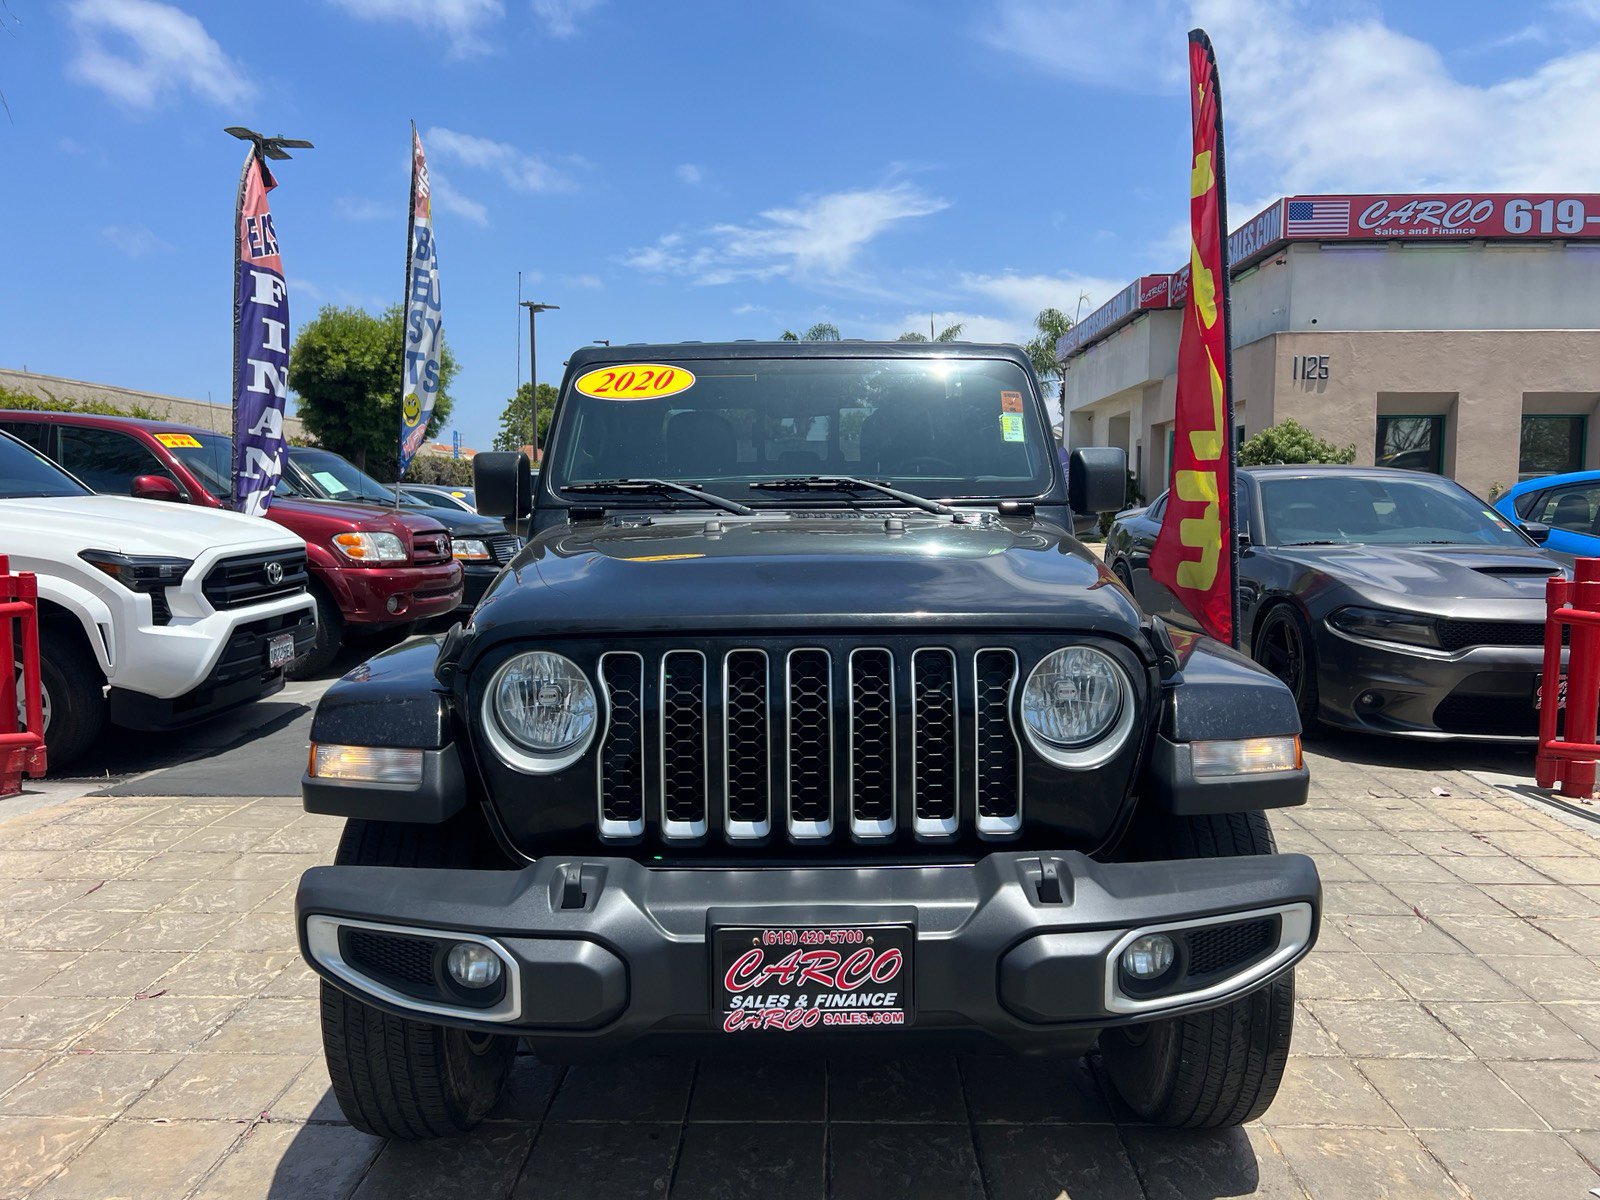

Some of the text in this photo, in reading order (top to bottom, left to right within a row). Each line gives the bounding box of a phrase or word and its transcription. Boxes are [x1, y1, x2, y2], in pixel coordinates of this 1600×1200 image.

[1358, 199, 1495, 229] CARCO
[1375, 227, 1476, 236] Sales and Finance
[1292, 354, 1330, 380] 1125
[593, 369, 675, 393] 2020
[762, 929, 864, 946] (619) 420-5700
[724, 947, 903, 993] CARCO
[729, 992, 898, 1009] SALES & FINANCE
[723, 1007, 905, 1033] CARCO SALES.COM
